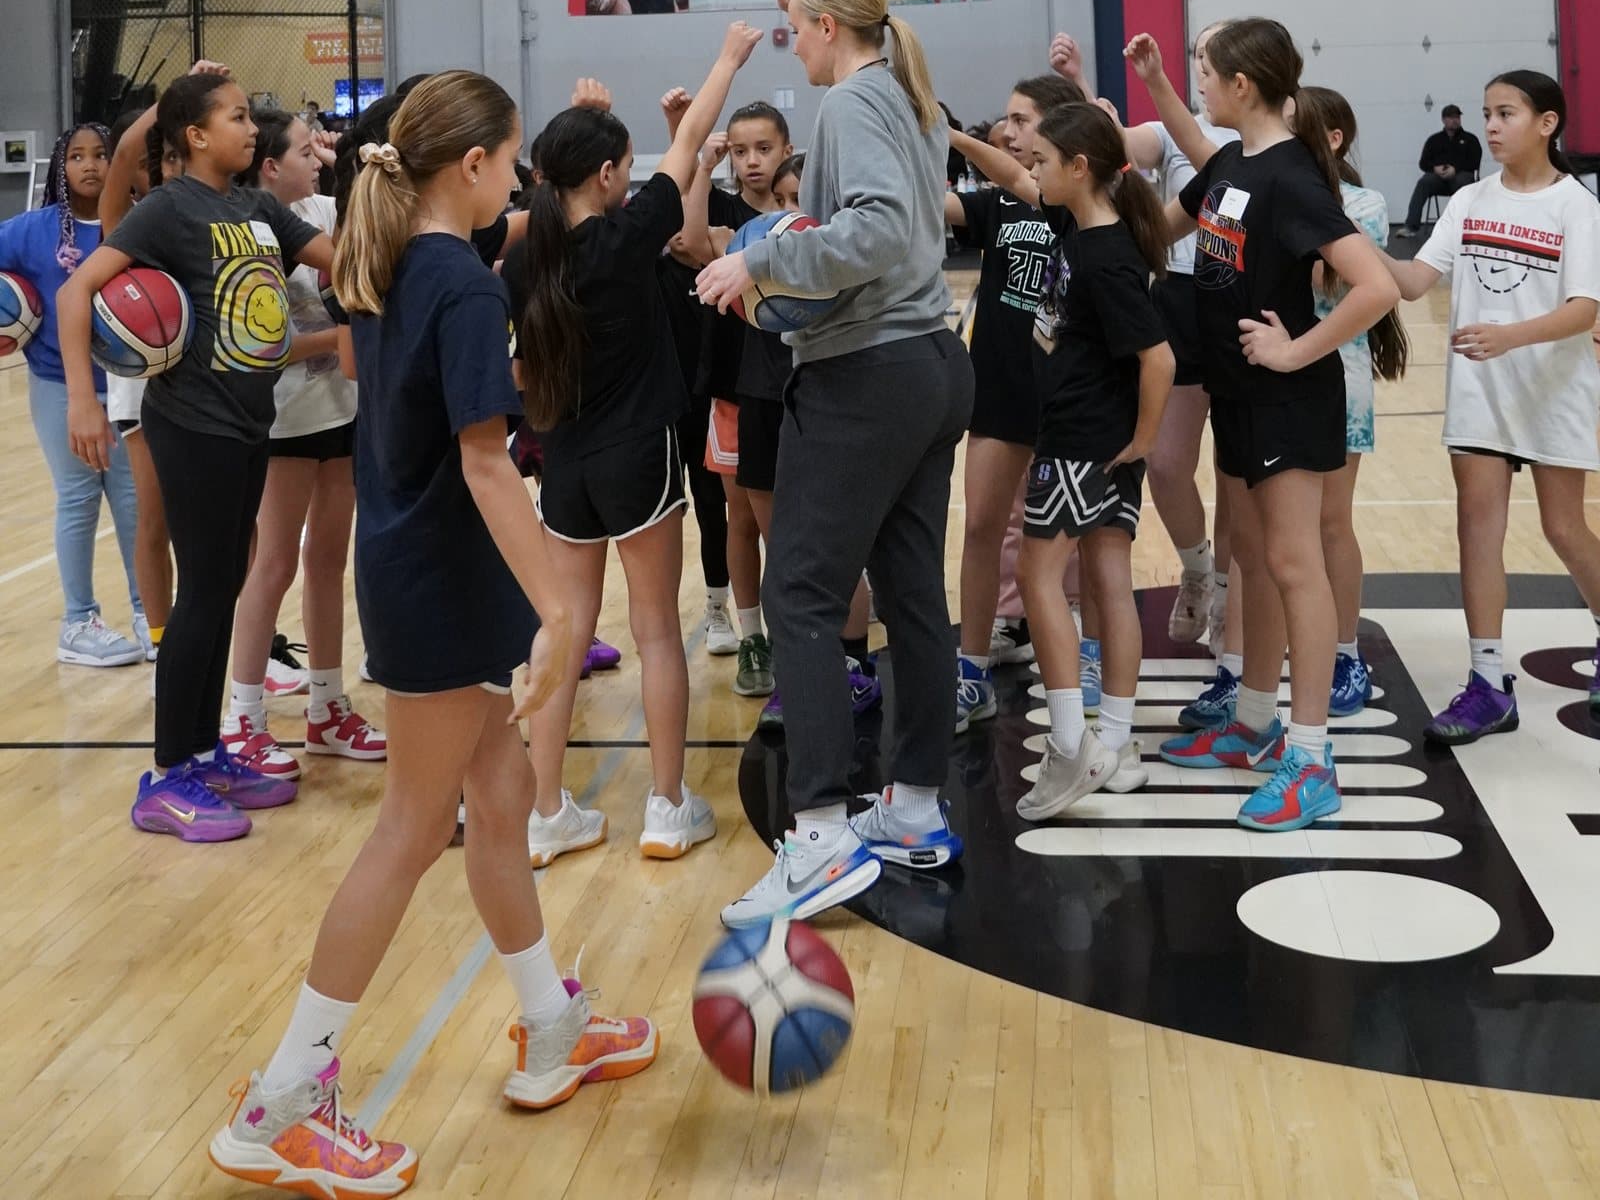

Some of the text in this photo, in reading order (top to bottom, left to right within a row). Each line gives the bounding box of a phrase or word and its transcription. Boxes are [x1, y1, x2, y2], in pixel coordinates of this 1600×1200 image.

[1462, 218, 1564, 247] SABRINA IONESCU
[1007, 247, 1050, 297] 20
